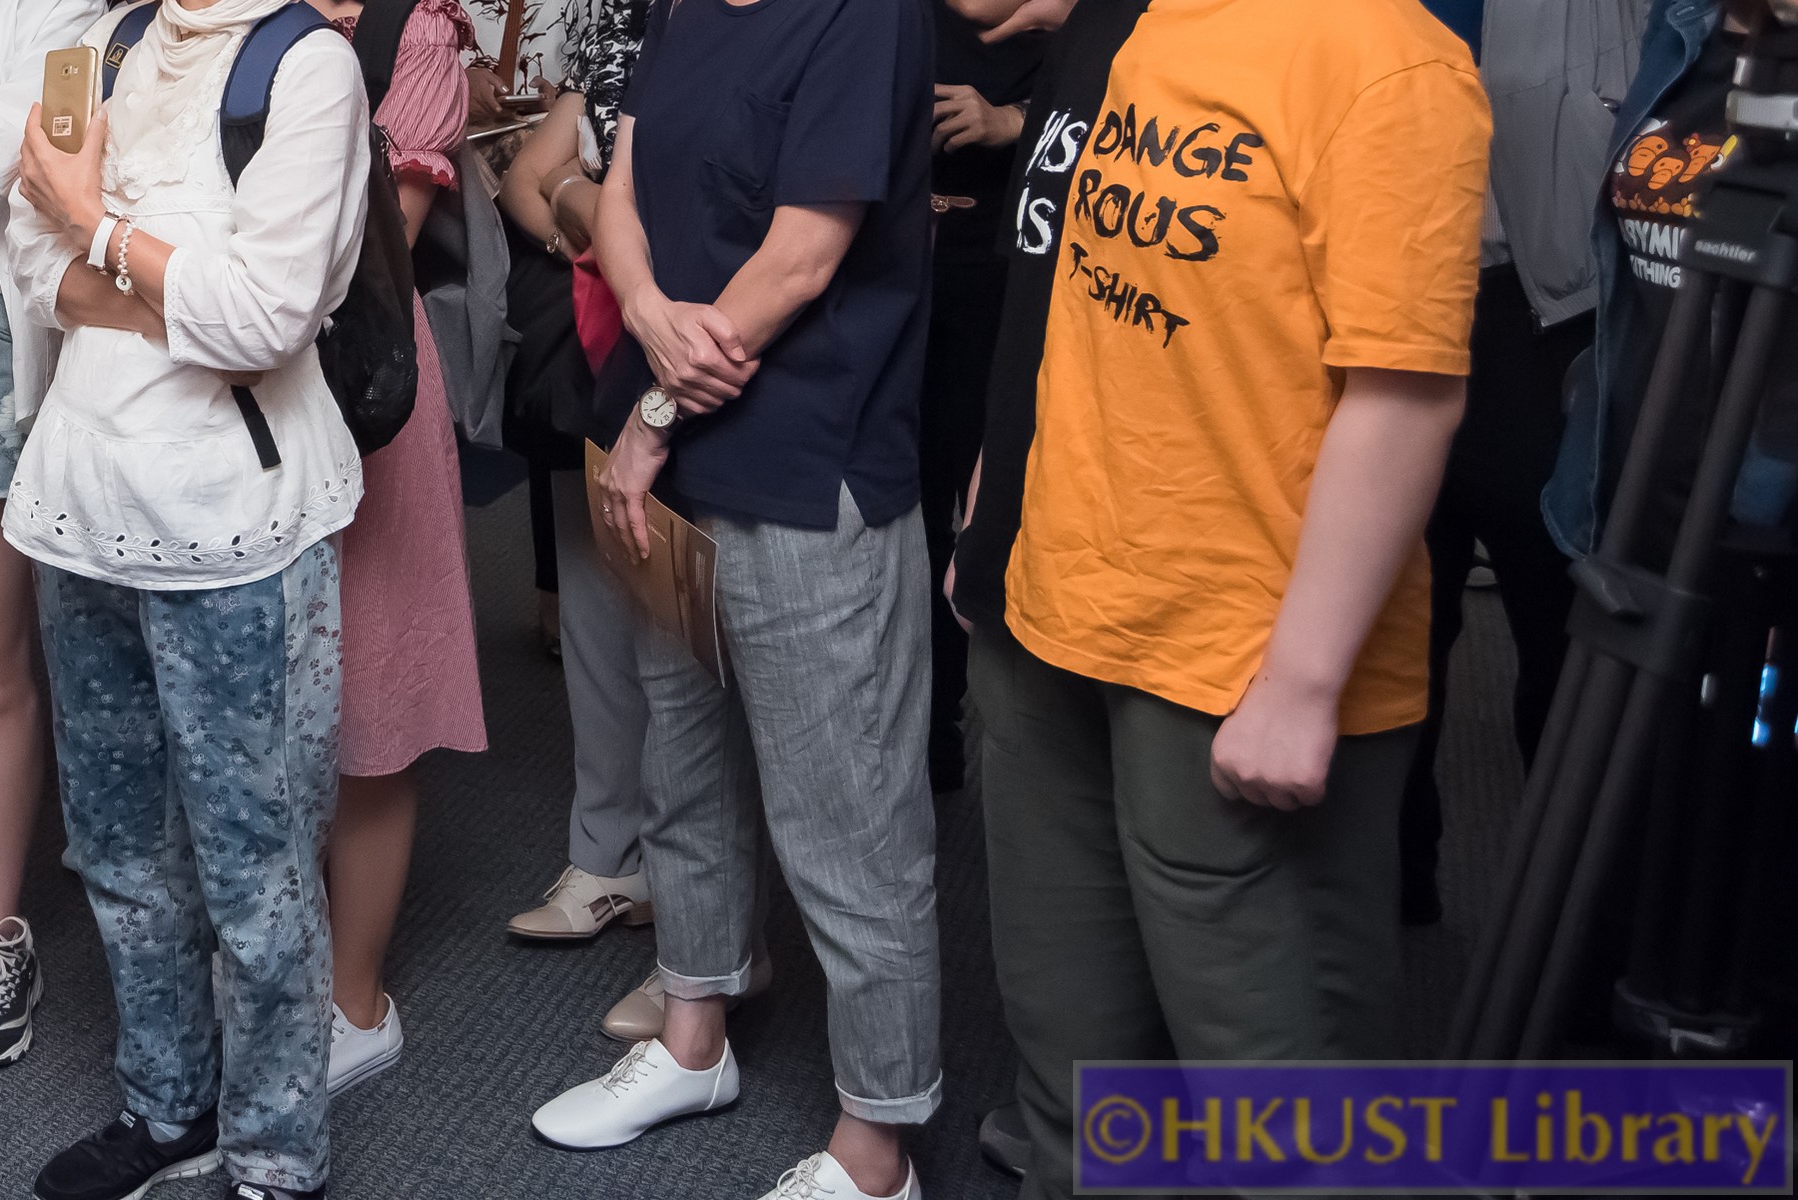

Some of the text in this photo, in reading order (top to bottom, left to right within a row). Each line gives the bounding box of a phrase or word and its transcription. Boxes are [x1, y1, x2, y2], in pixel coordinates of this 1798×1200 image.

[1093, 103, 1265, 181] DANGE
[1016, 182, 1057, 255] IS
[1073, 169, 1226, 262] ROUS
[1069, 241, 1190, 348] T-SHIRT
